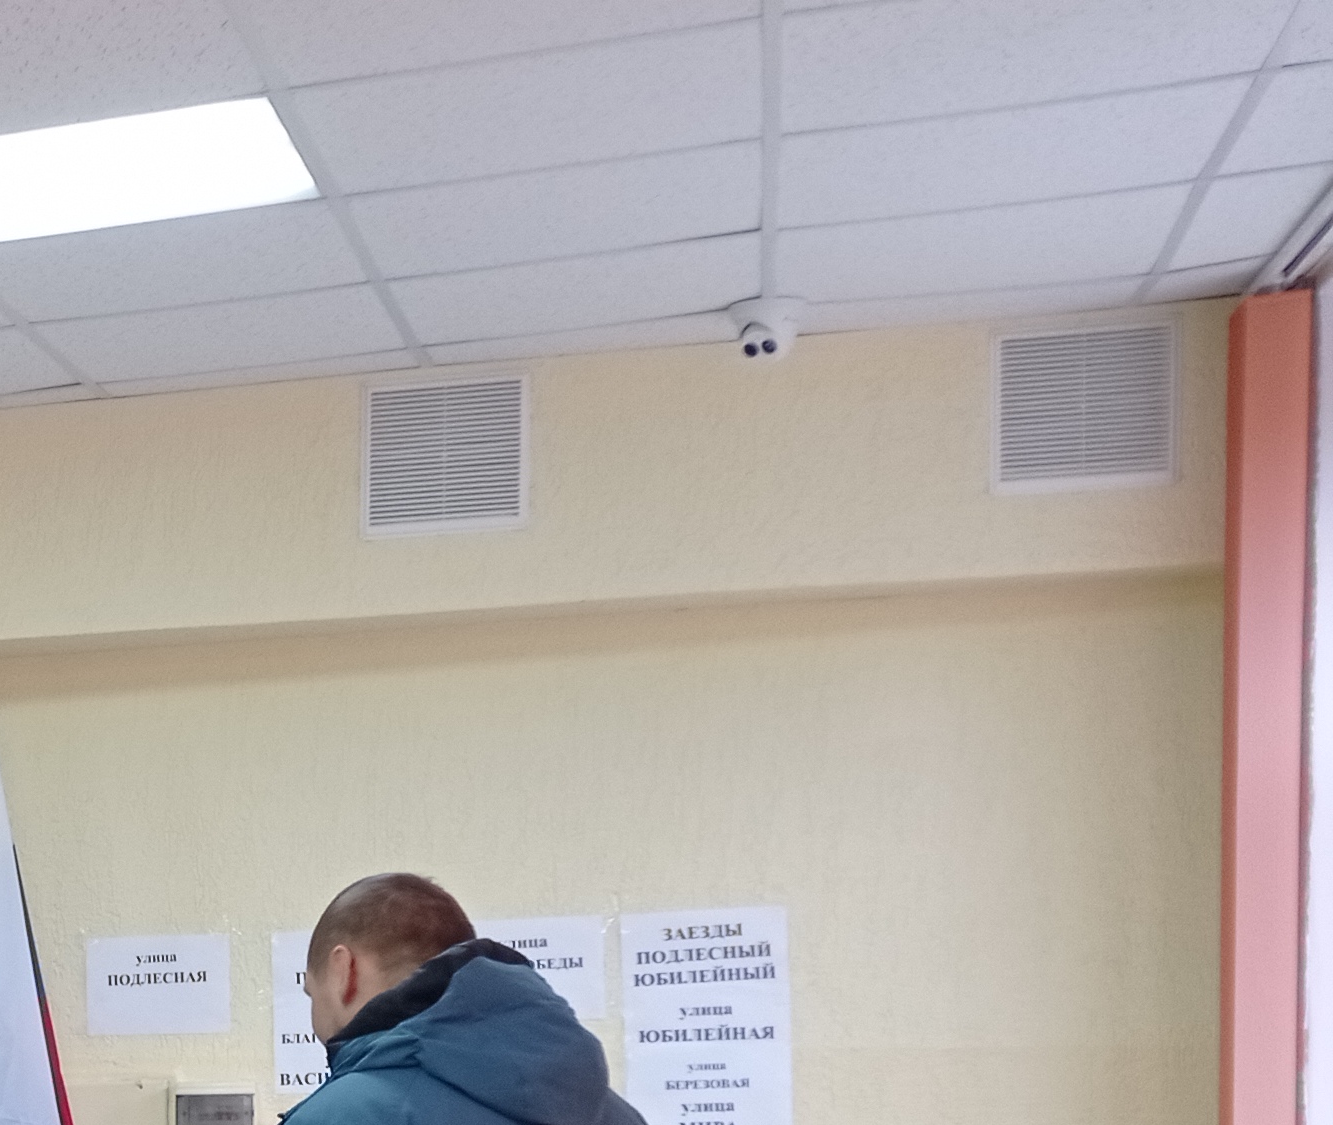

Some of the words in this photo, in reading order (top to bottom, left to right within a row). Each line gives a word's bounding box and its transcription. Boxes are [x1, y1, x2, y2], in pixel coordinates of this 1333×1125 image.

[662, 923, 743, 941] ЗАЕЗДЫ
[135, 954, 177, 967] улица
[636, 941, 771, 965] ПОДЛЕСНЫЙ
[536, 957, 583, 970] БЕДЫ
[108, 971, 207, 987] ПОДЛЕСНАЯ
[633, 963, 776, 987] ЮБИЛЕЙНЫЙ
[679, 1005, 733, 1020] улица
[639, 1024, 775, 1043] ЮБИЛЕЙНАЯ
[686, 1063, 727, 1074] улица
[665, 1078, 750, 1091] БЕРЕЗОВАЯ
[681, 1102, 735, 1116] улица
